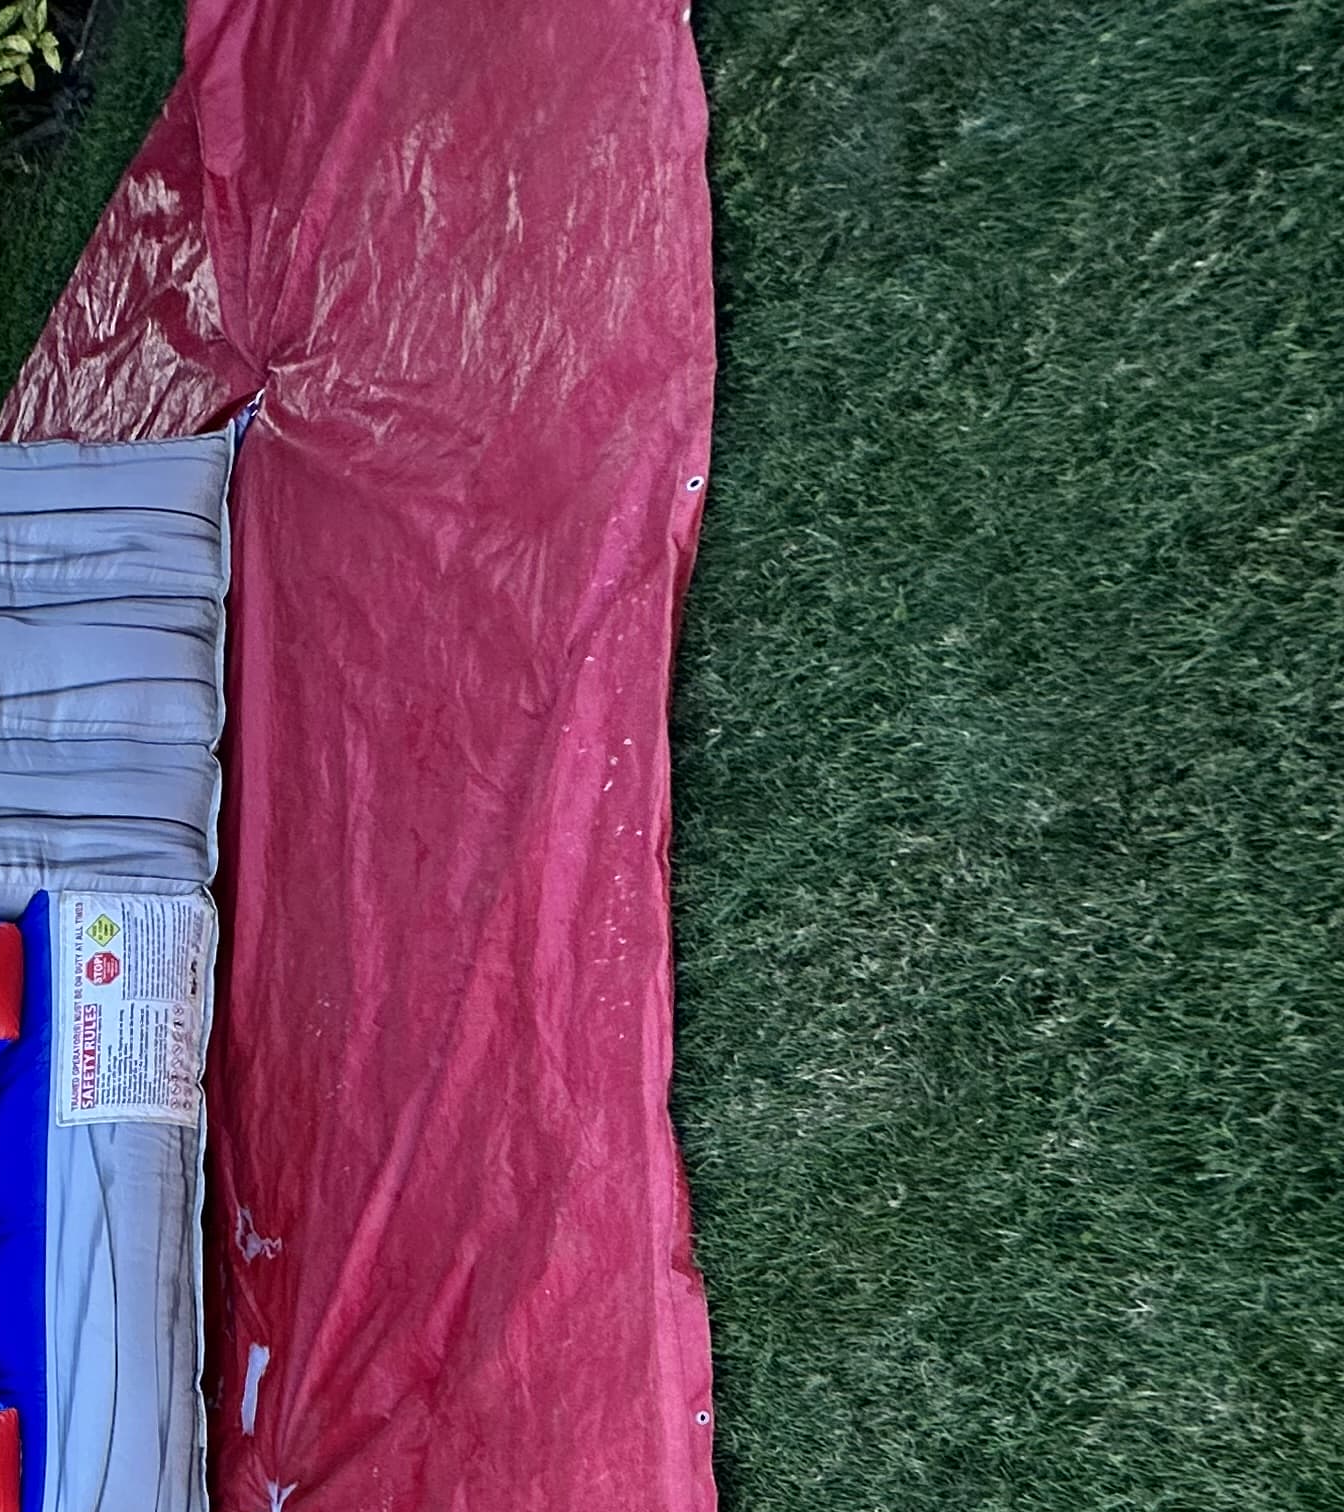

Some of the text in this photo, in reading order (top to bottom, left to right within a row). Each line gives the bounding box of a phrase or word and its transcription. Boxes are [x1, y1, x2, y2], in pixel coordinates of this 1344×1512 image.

[76, 943, 83, 951] AT
[94, 955, 103, 983] STOP!
[82, 1005, 96, 1108] SAFETY RULES
